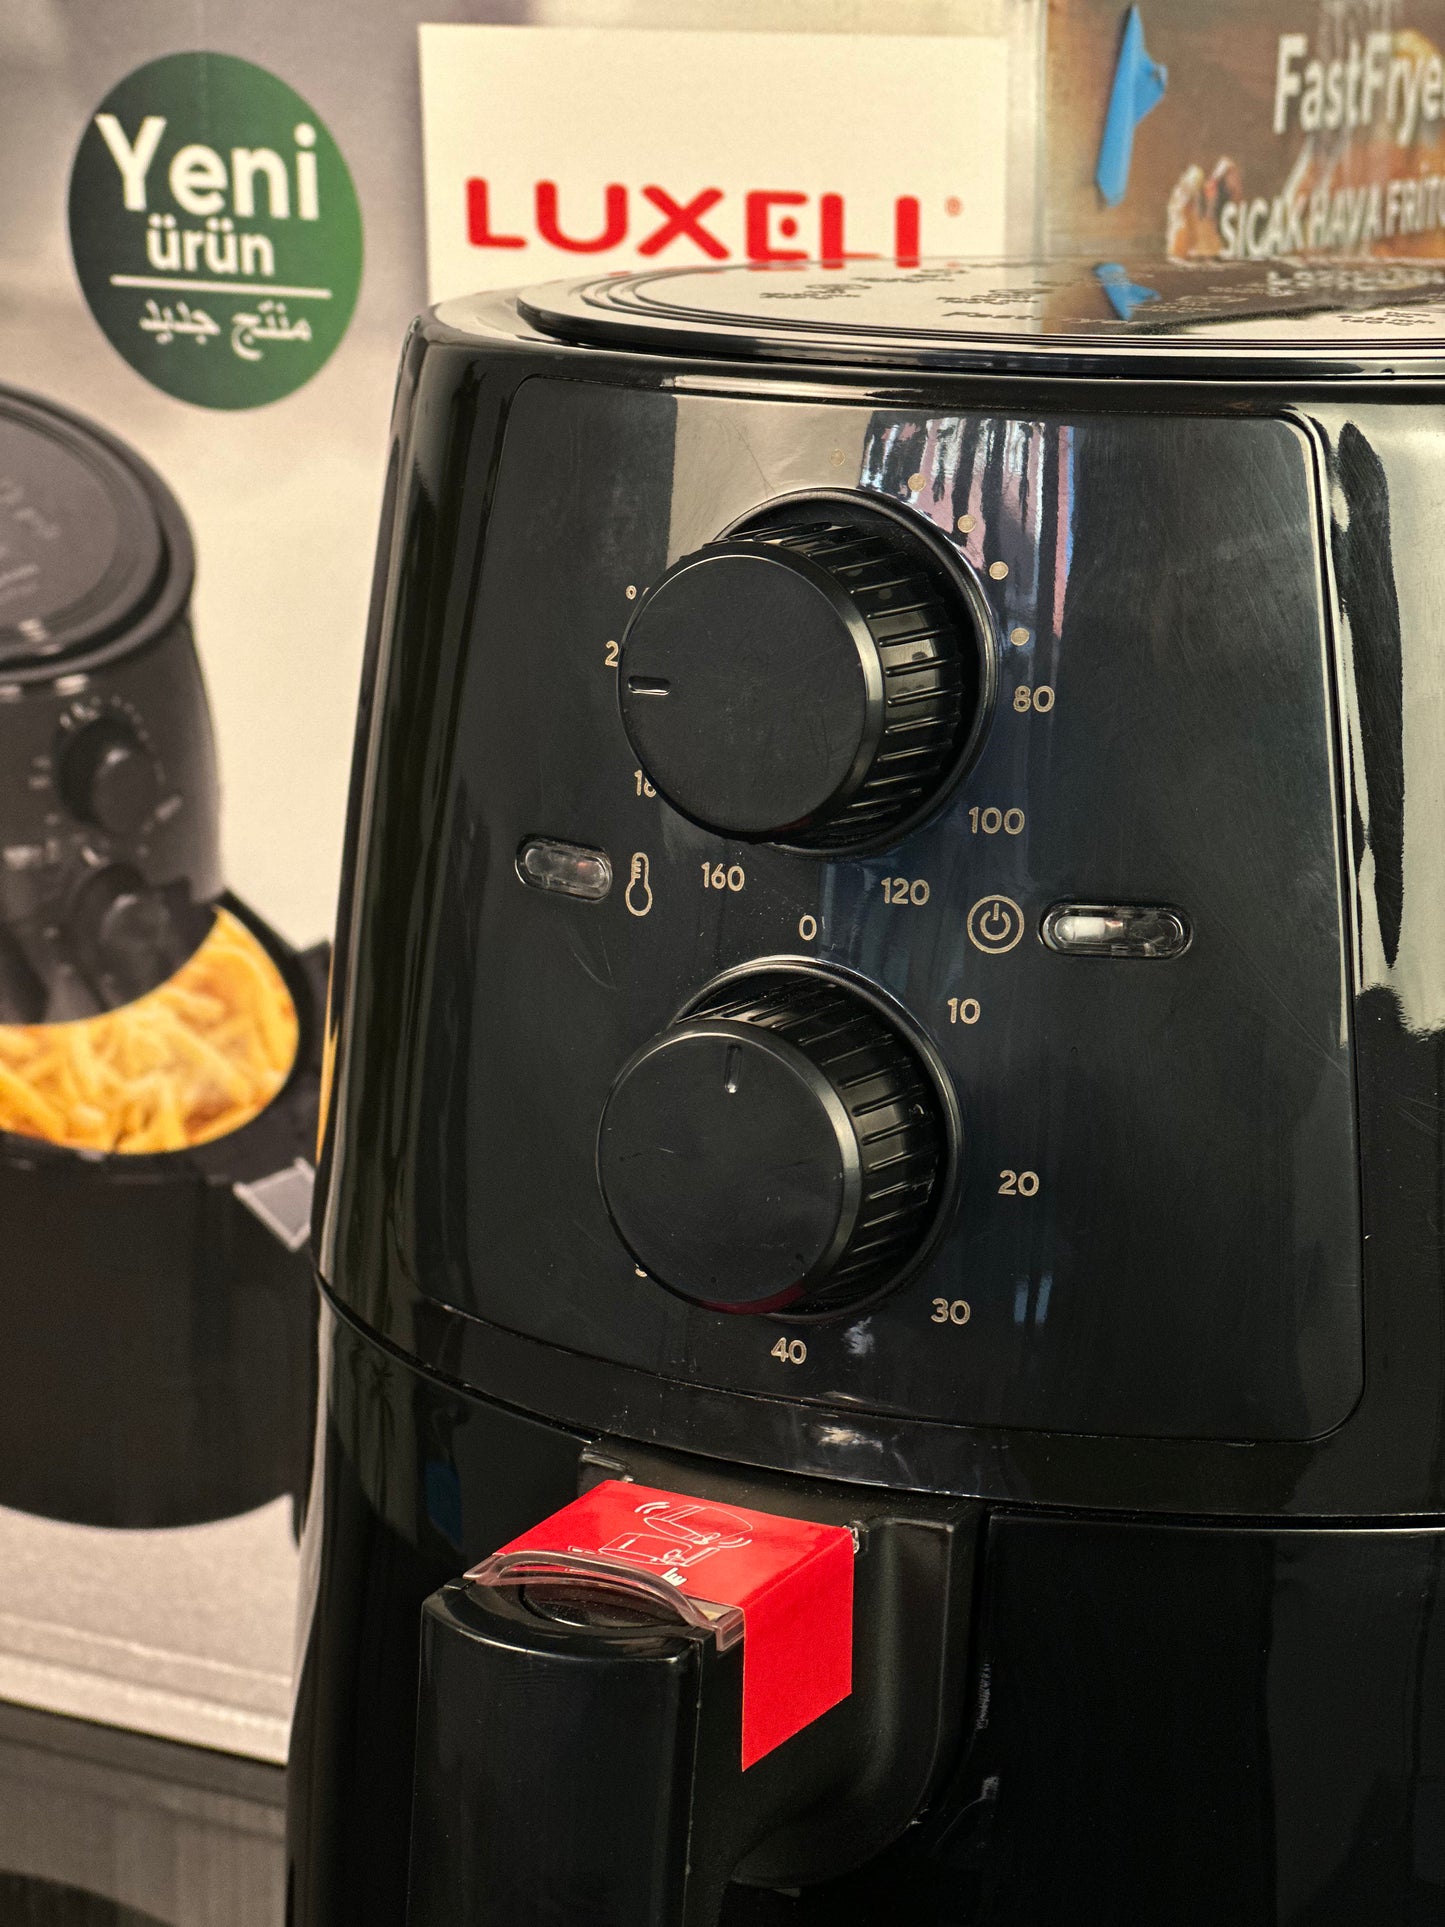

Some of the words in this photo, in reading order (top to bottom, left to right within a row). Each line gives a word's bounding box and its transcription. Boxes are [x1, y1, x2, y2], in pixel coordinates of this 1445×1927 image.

[1274, 32, 1445, 146] FastFrye
[95, 113, 319, 220] Yeni
[146, 213, 275, 277] ürün
[139, 300, 221, 345] جديد
[231, 300, 312, 361] منتج
[1011, 685, 1056, 714] 80
[968, 806, 1026, 835] 100
[700, 861, 746, 892] 160
[880, 877, 931, 907] 120
[798, 913, 818, 942] 0
[947, 997, 981, 1025] 10
[997, 1169, 1040, 1197] 20
[930, 1297, 972, 1325] 30
[770, 1336, 808, 1365] 40
